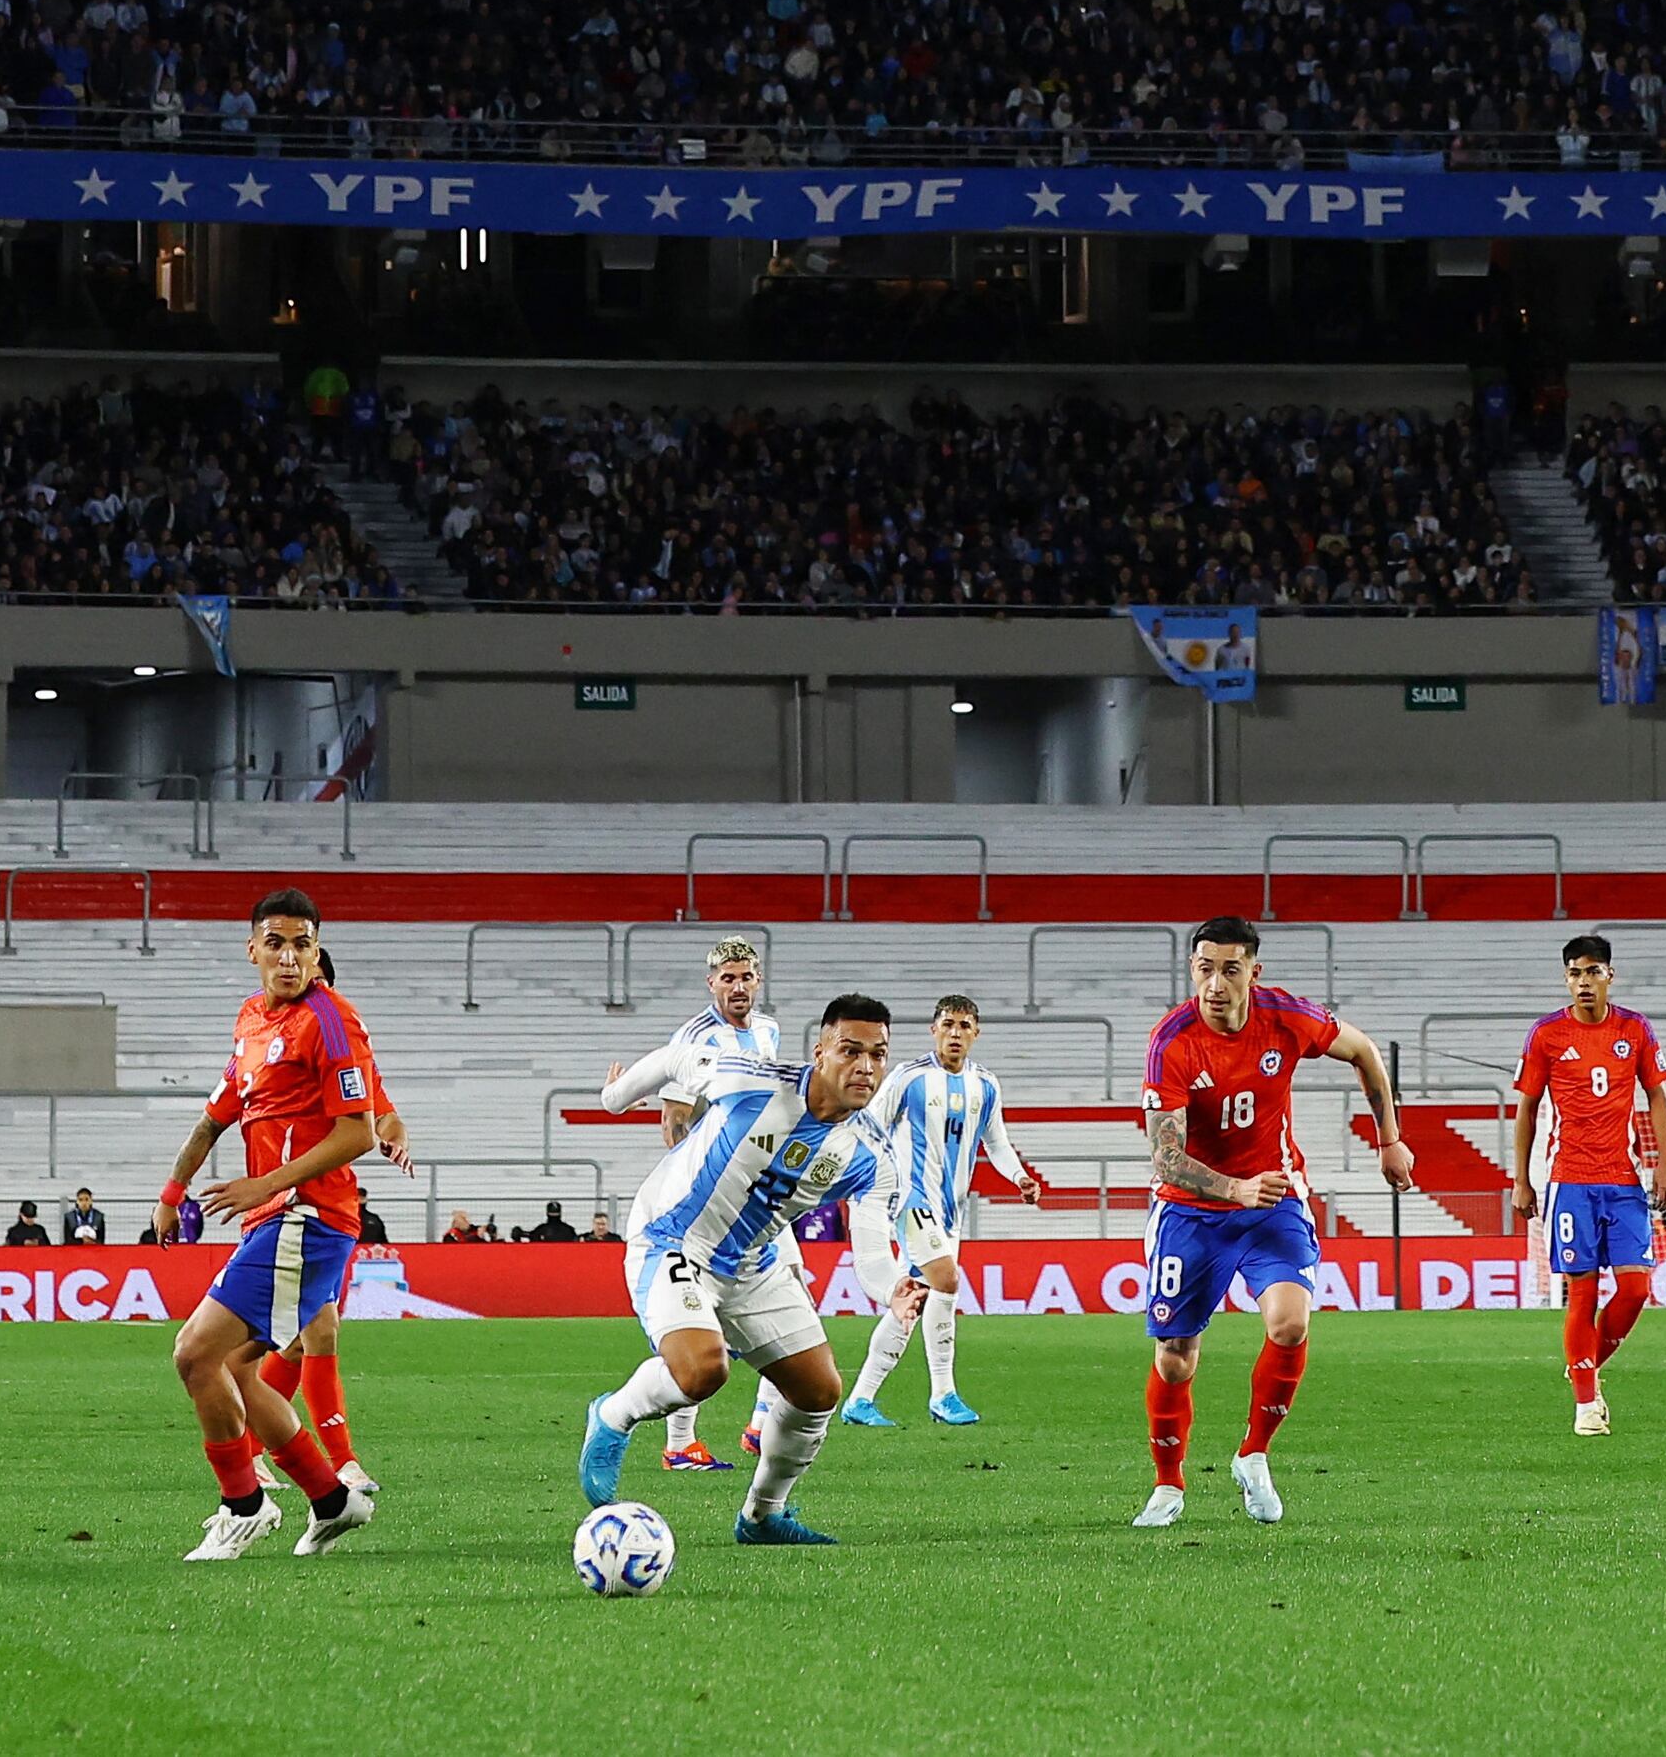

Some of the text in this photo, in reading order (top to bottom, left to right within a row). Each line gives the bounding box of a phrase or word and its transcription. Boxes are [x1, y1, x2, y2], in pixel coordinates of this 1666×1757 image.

[310, 172, 476, 216] YPF
[799, 178, 962, 225] YPF
[1246, 183, 1405, 227] YPF
[582, 686, 629, 703] SALIDA
[1412, 686, 1459, 703] SALIDA
[1590, 1067, 1608, 1097] 8
[1221, 1091, 1255, 1130] 18
[945, 1117, 963, 1145] 14
[912, 1208, 937, 1231] 14
[1559, 1212, 1574, 1243] 8
[1151, 1250, 1183, 1298] 18
